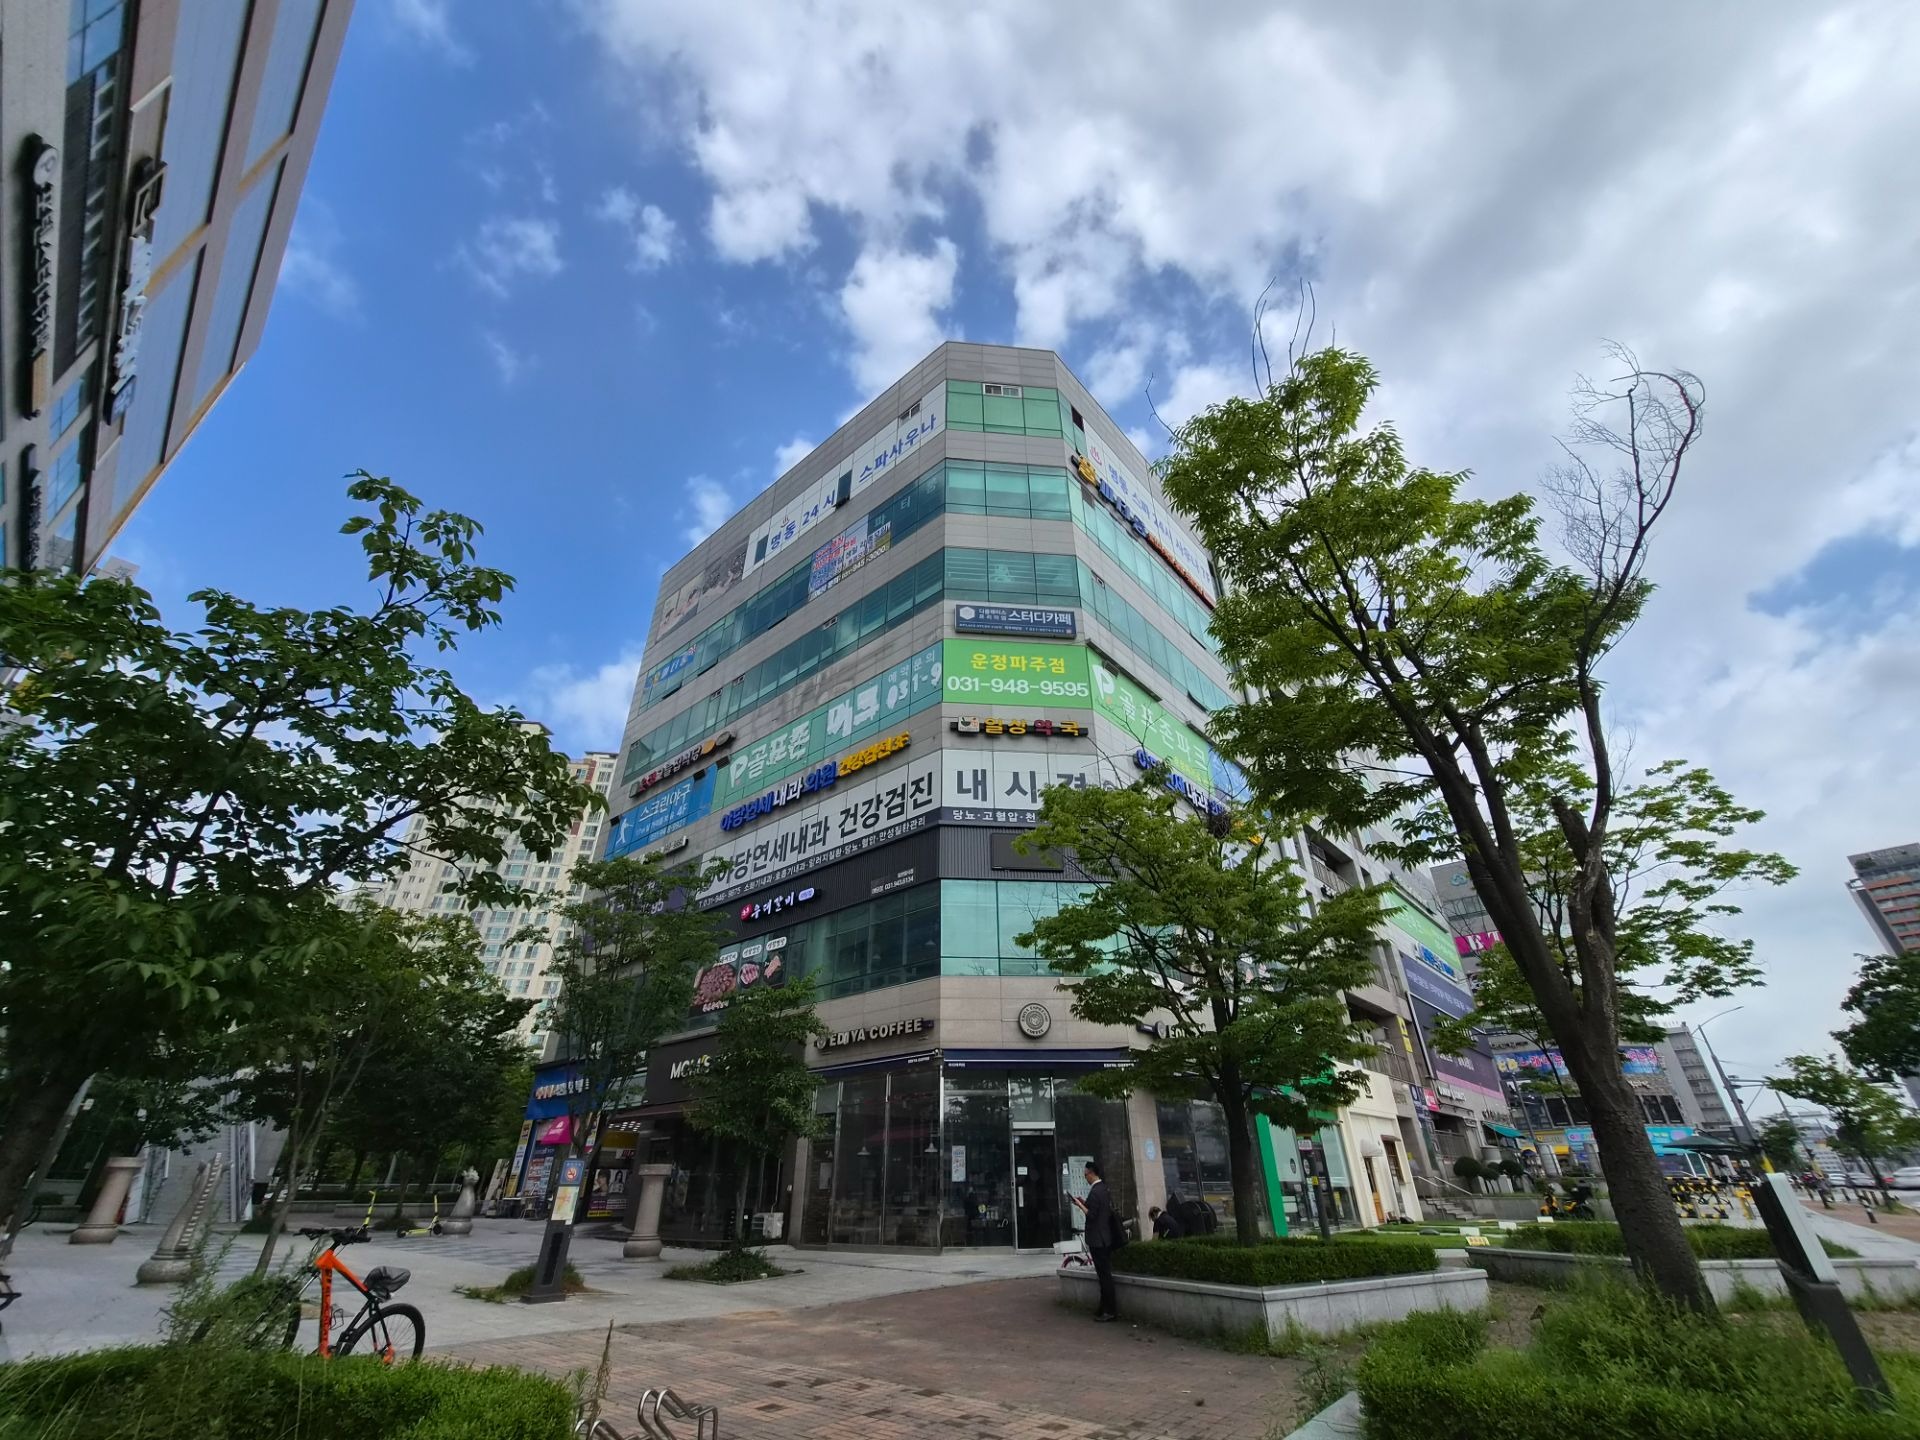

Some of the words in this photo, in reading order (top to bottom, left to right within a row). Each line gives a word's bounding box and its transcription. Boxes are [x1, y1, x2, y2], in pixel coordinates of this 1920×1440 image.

[770, 519, 796, 551] 명동
[1008, 610, 1072, 626] 스터디카페
[970, 652, 1066, 674] 운정파주점
[946, 675, 1089, 697] 031-948-9595
[984, 717, 1080, 737] 일상약국
[639, 783, 691, 822] 스크린야구
[838, 772, 933, 839] 건강검진
[829, 1028, 866, 1047] EDIYA
[869, 1017, 923, 1040] COFFEE
